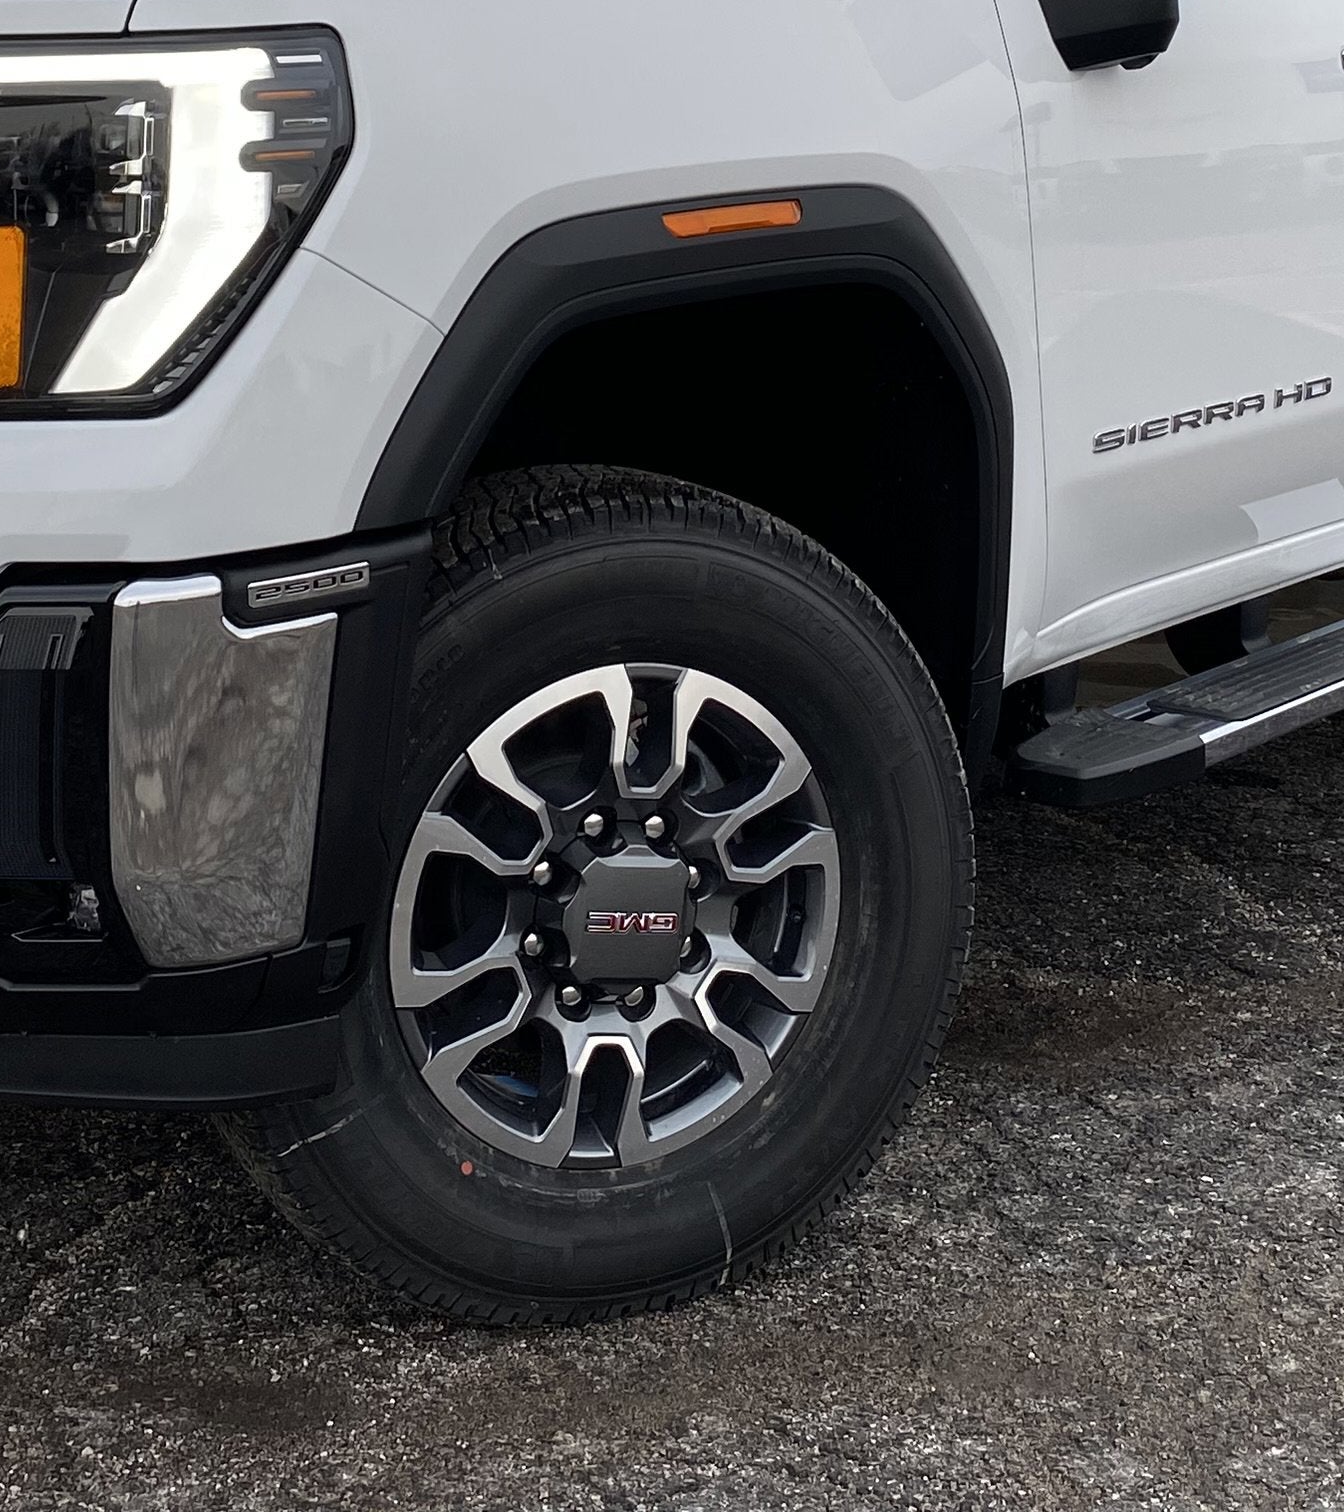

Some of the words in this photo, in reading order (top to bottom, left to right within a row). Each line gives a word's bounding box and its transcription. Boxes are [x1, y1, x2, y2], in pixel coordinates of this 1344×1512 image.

[1092, 393, 1264, 454] SIERRA
[1273, 376, 1332, 409] HD
[256, 570, 364, 600] 2500
[587, 911, 679, 934] GMC
